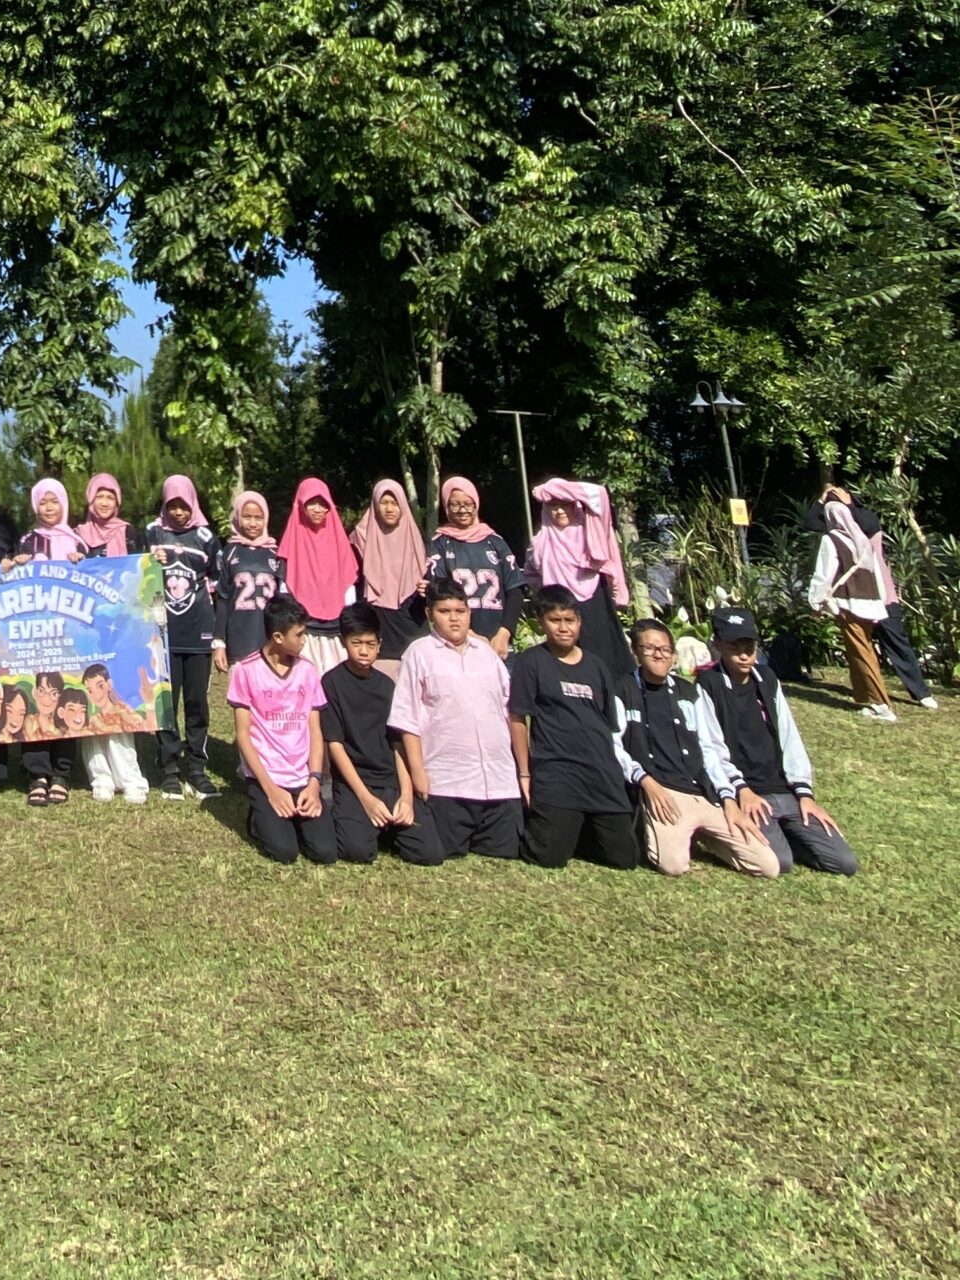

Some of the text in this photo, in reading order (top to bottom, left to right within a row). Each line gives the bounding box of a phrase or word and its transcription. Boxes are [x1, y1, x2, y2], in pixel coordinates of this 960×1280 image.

[40, 565, 68, 580] AND
[234, 572, 276, 610] 23
[8, 617, 65, 639] EVENT
[8, 641, 40, 650] Primary
[16, 649, 36, 658] 2024
[43, 648, 63, 657] 2025
[1, 660, 25, 668] Green
[27, 657, 51, 666] World
[265, 711, 307, 721] Emirates
